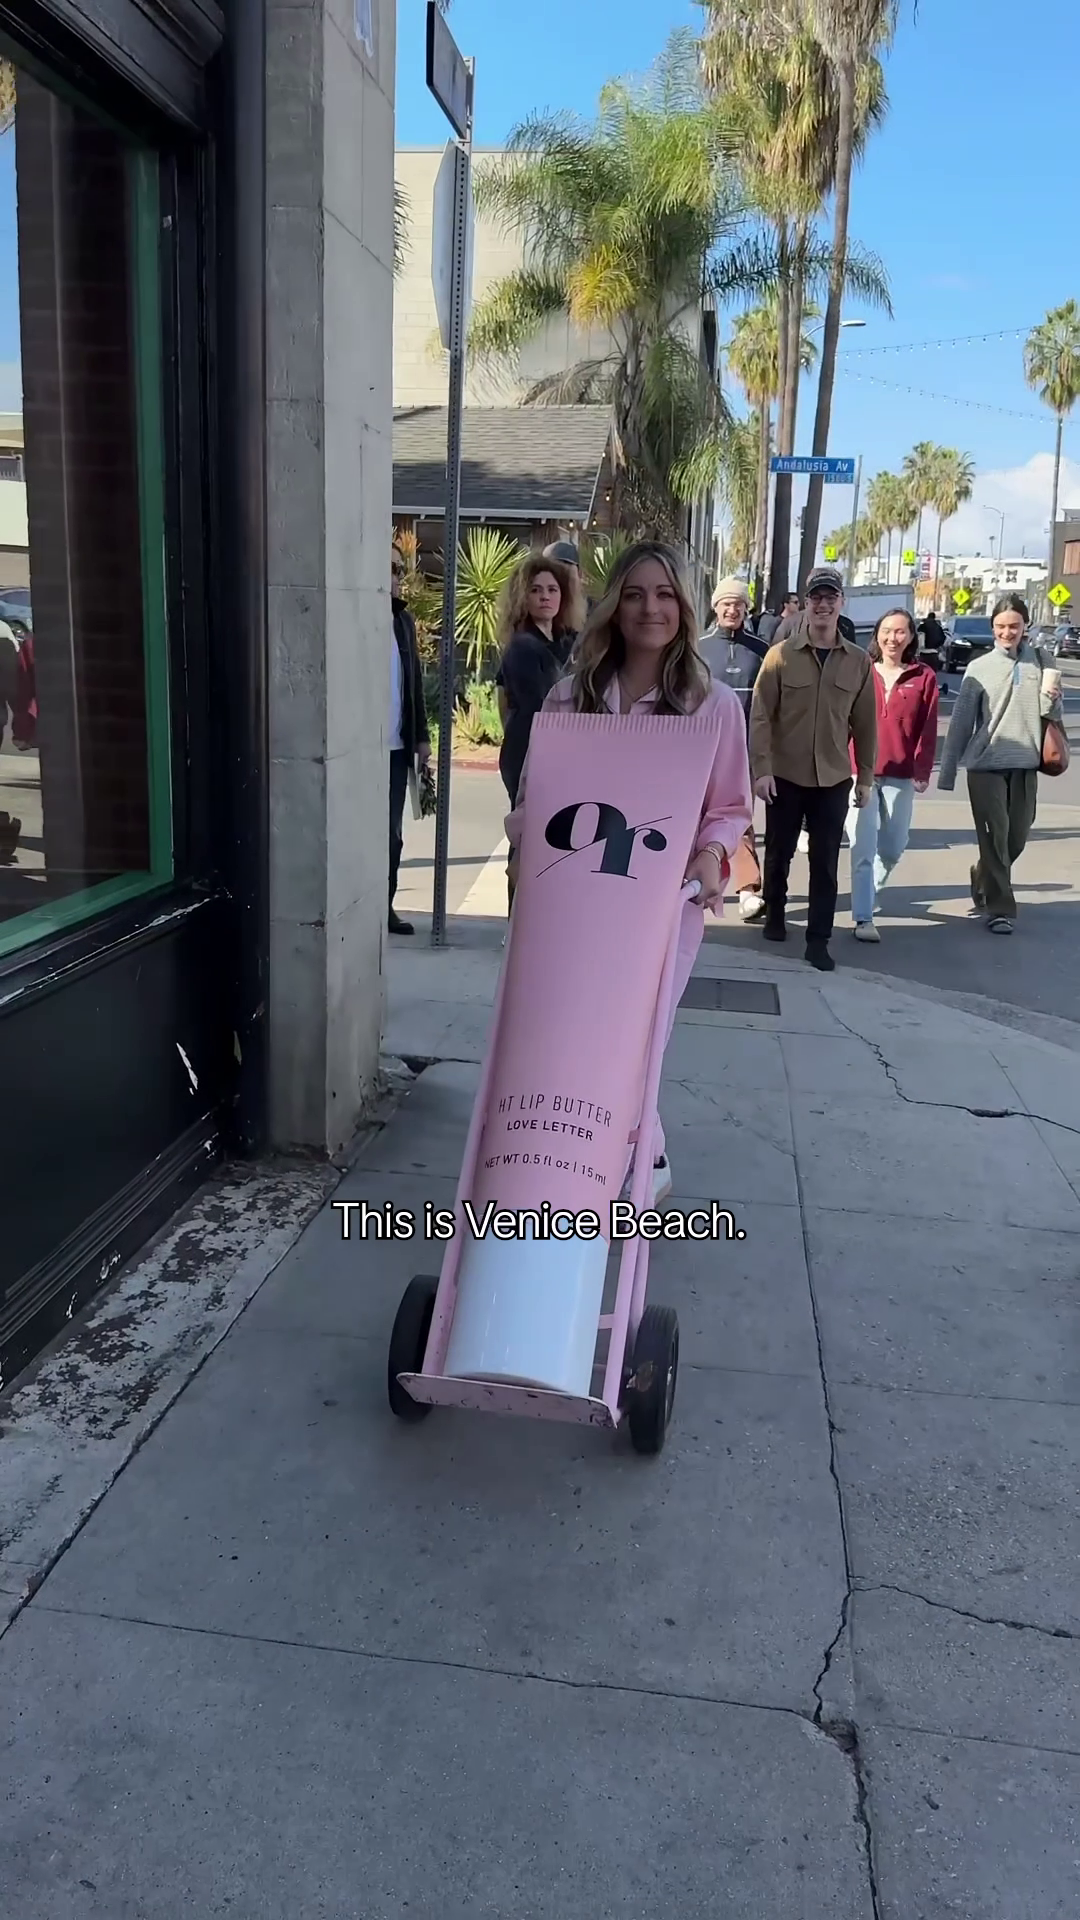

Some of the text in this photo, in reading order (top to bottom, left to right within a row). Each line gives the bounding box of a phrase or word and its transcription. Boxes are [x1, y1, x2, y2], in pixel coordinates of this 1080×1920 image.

[776, 459, 849, 472] Andalusia Av
[520, 1093, 545, 1110] LIP
[553, 1095, 612, 1127] BUTTER
[507, 1119, 594, 1141] LOVE LETTER
[484, 1155, 501, 1169] NET
[503, 1153, 520, 1165] WT
[522, 1153, 541, 1165] 0.5
[555, 1159, 570, 1170] oz
